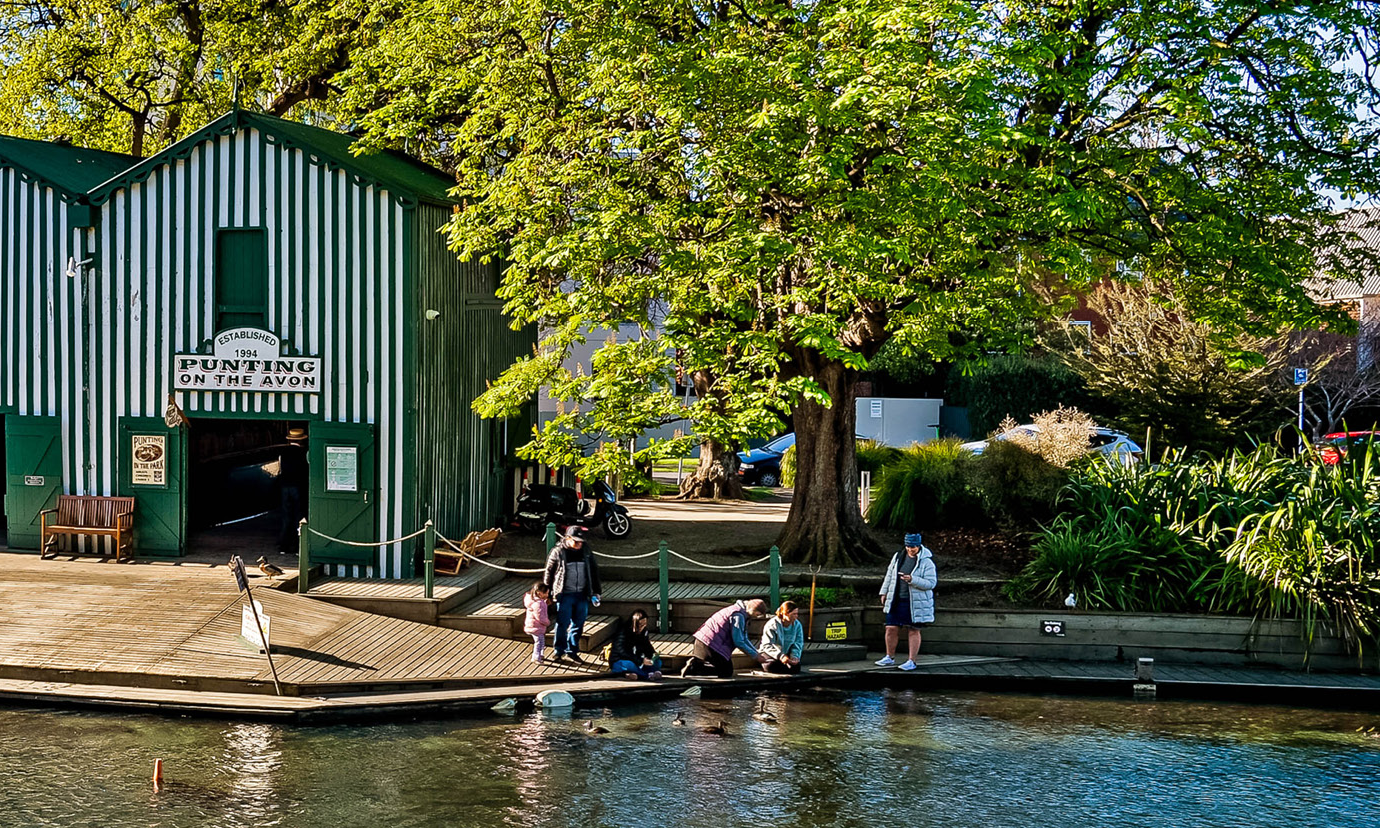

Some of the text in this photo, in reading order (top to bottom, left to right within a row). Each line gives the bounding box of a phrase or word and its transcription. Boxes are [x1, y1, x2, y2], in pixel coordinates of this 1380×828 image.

[218, 330, 277, 347] ESTABLISHED
[234, 349, 258, 359] 1994
[178, 358, 316, 375] PUNTING
[179, 373, 316, 389] ON THE AVON
[133, 436, 164, 448] PUNTING
[150, 460, 164, 470] PARK
